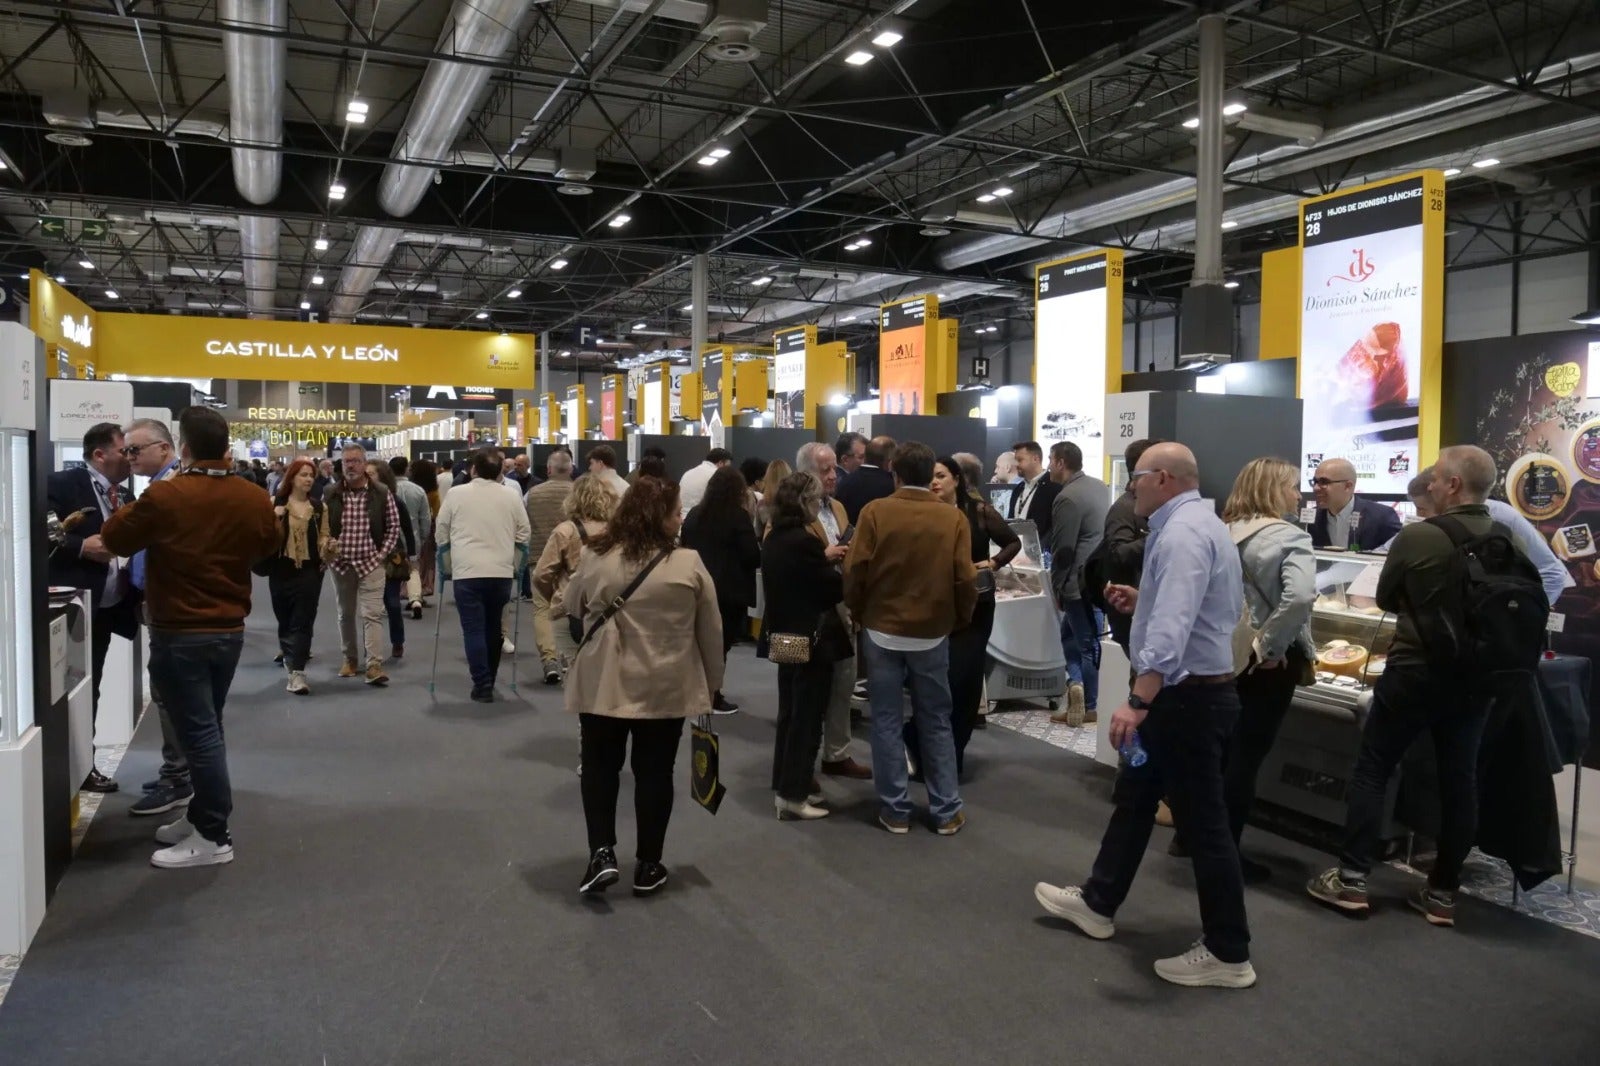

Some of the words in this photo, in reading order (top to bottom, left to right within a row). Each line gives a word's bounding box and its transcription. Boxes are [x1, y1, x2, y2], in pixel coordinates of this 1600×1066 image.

[1430, 187, 1444, 197] 4F23
[1327, 206, 1347, 217] HIJOS
[1348, 203, 1357, 213] DE
[1358, 195, 1387, 210] DIONISIO
[1388, 187, 1423, 202] SÁNCHEZ
[1431, 199, 1442, 211] 28
[1305, 211, 1322, 222] 4F23
[1306, 222, 1320, 237] 28
[1112, 268, 1121, 277] 29
[1040, 282, 1049, 293] 29
[1305, 291, 1357, 312] Dionisio
[1361, 283, 1418, 302] Sánchez
[581, 327, 590, 345] F
[206, 340, 317, 359] CASTILLA
[321, 345, 336, 359] Y
[341, 344, 399, 362] LEÓN
[975, 360, 987, 376] H
[248, 407, 356, 422] RESTAURANTE
[1119, 412, 1136, 420] 4F23
[1120, 424, 1133, 438] 28
